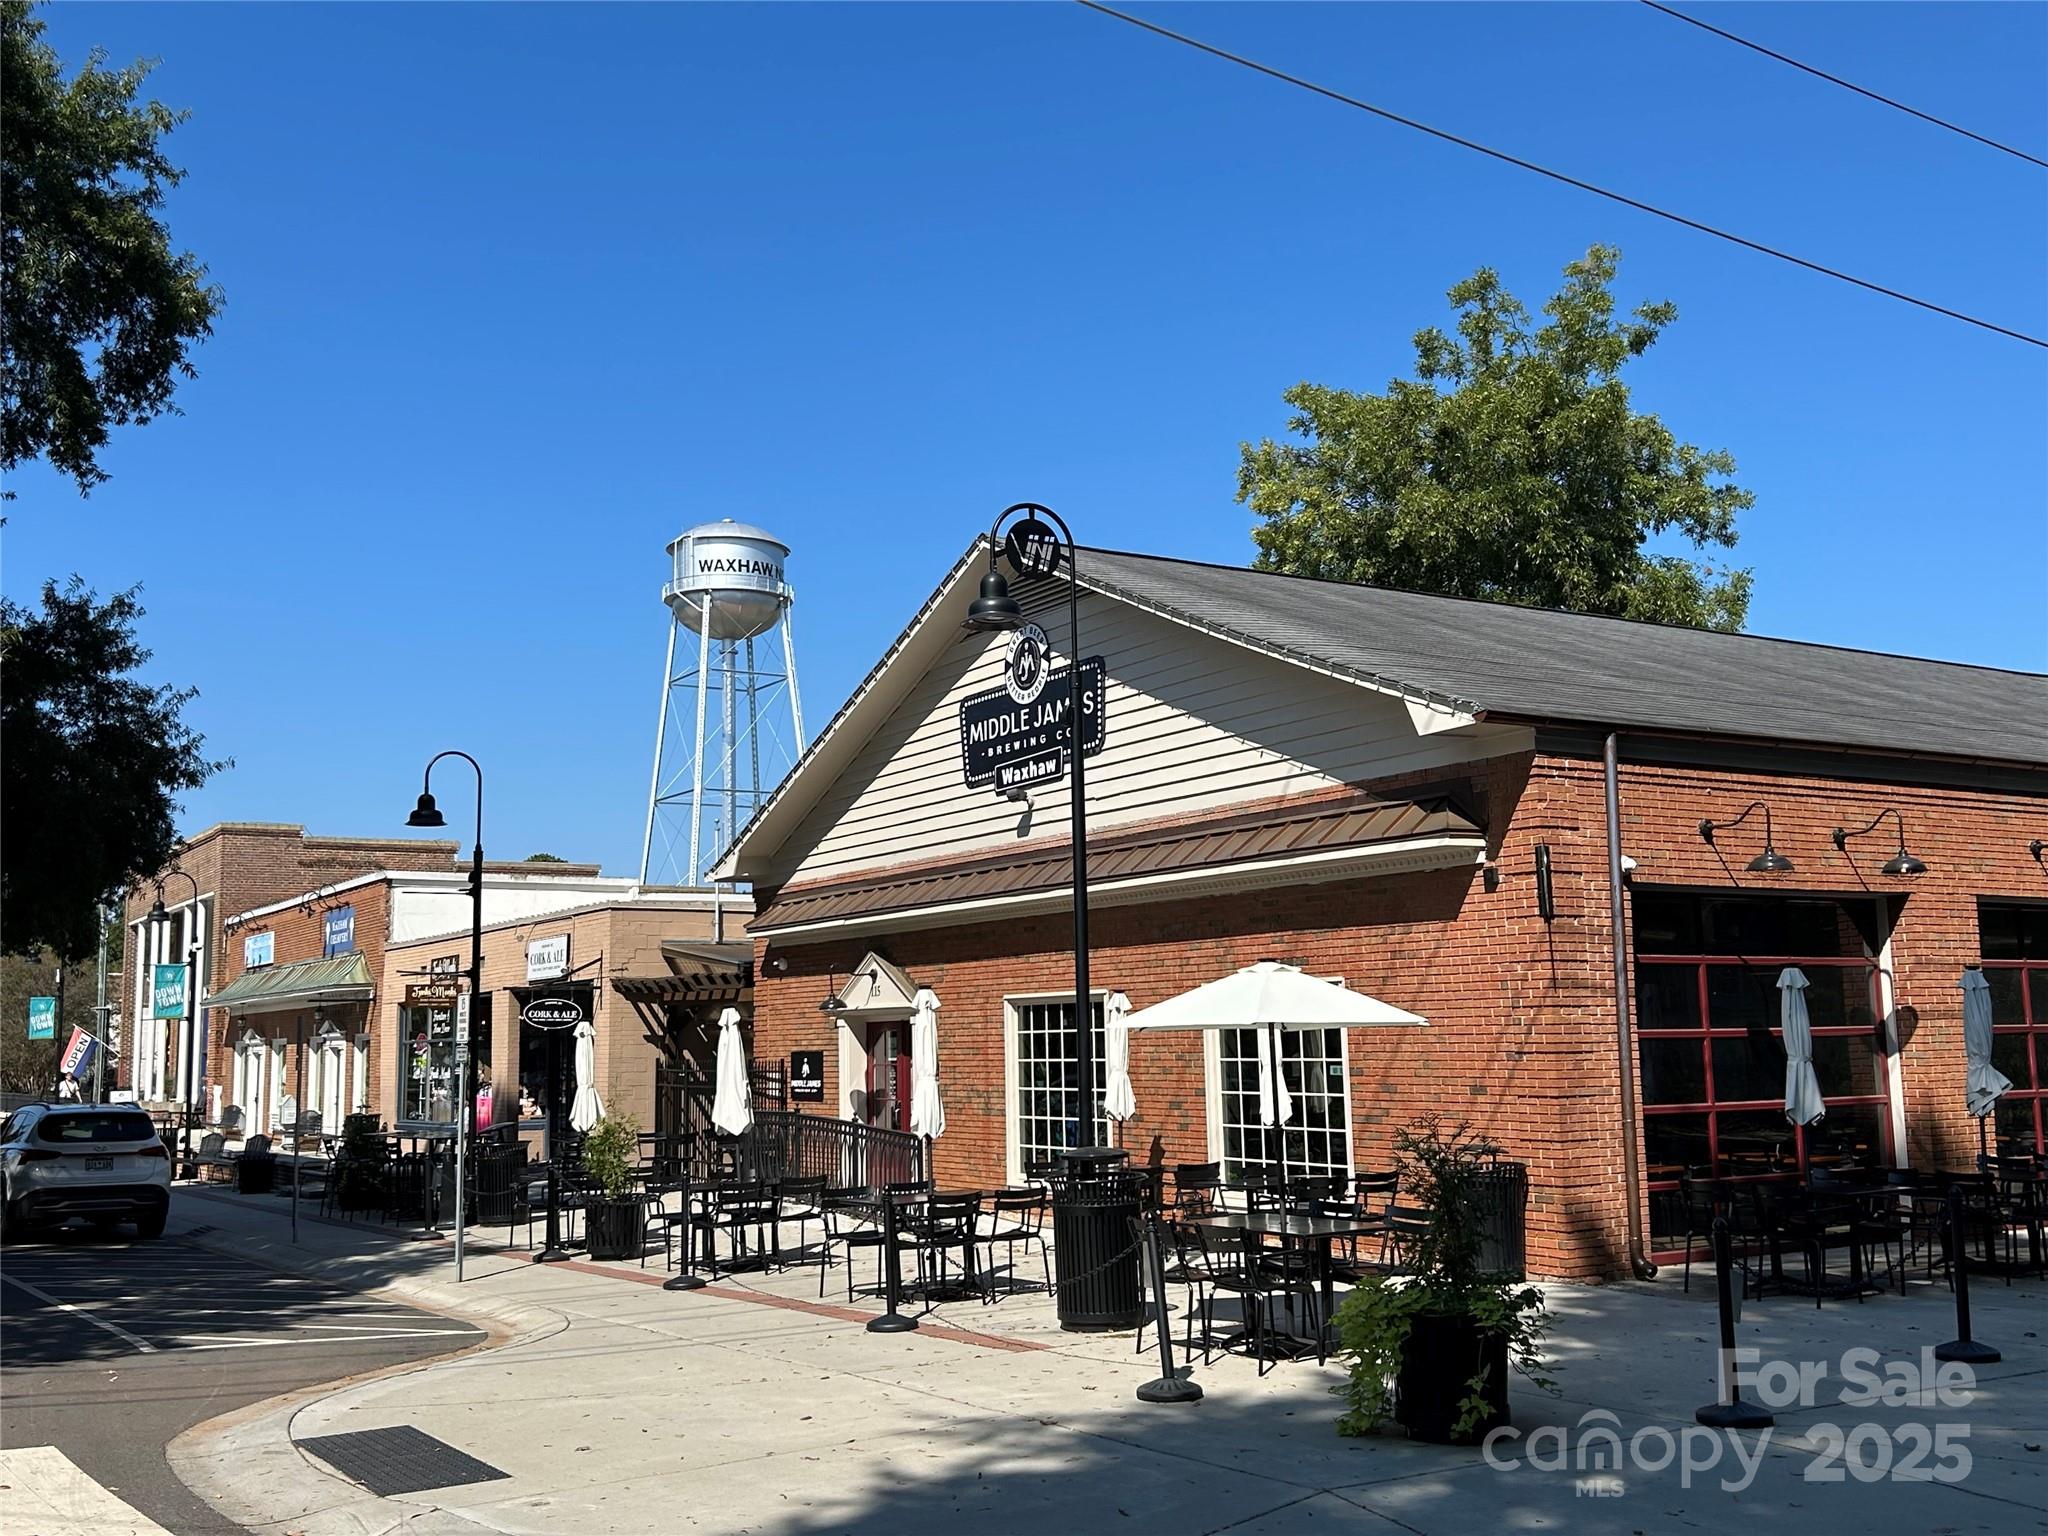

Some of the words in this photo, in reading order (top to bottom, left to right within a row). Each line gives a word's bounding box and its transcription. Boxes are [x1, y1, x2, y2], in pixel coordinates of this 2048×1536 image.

[698, 558, 773, 577] WAXHAW
[1030, 626, 1044, 644] BEER
[969, 708, 1030, 745] MIDDLE
[1033, 691, 1094, 728] JAMS
[988, 734, 1047, 757] BREWING
[1001, 758, 1057, 785] Waxhaw
[530, 951, 546, 966] CORK
[546, 950, 552, 964] &
[553, 948, 565, 963] ALE
[155, 984, 182, 999] DOWN
[157, 993, 184, 1009] TOWN
[30, 1013, 51, 1025] DOWN
[528, 1010, 552, 1019] CORK
[552, 1010, 561, 1019] &
[561, 1010, 578, 1019] ALE
[32, 1019, 53, 1032] TOWN
[67, 1038, 89, 1069] OPEN
